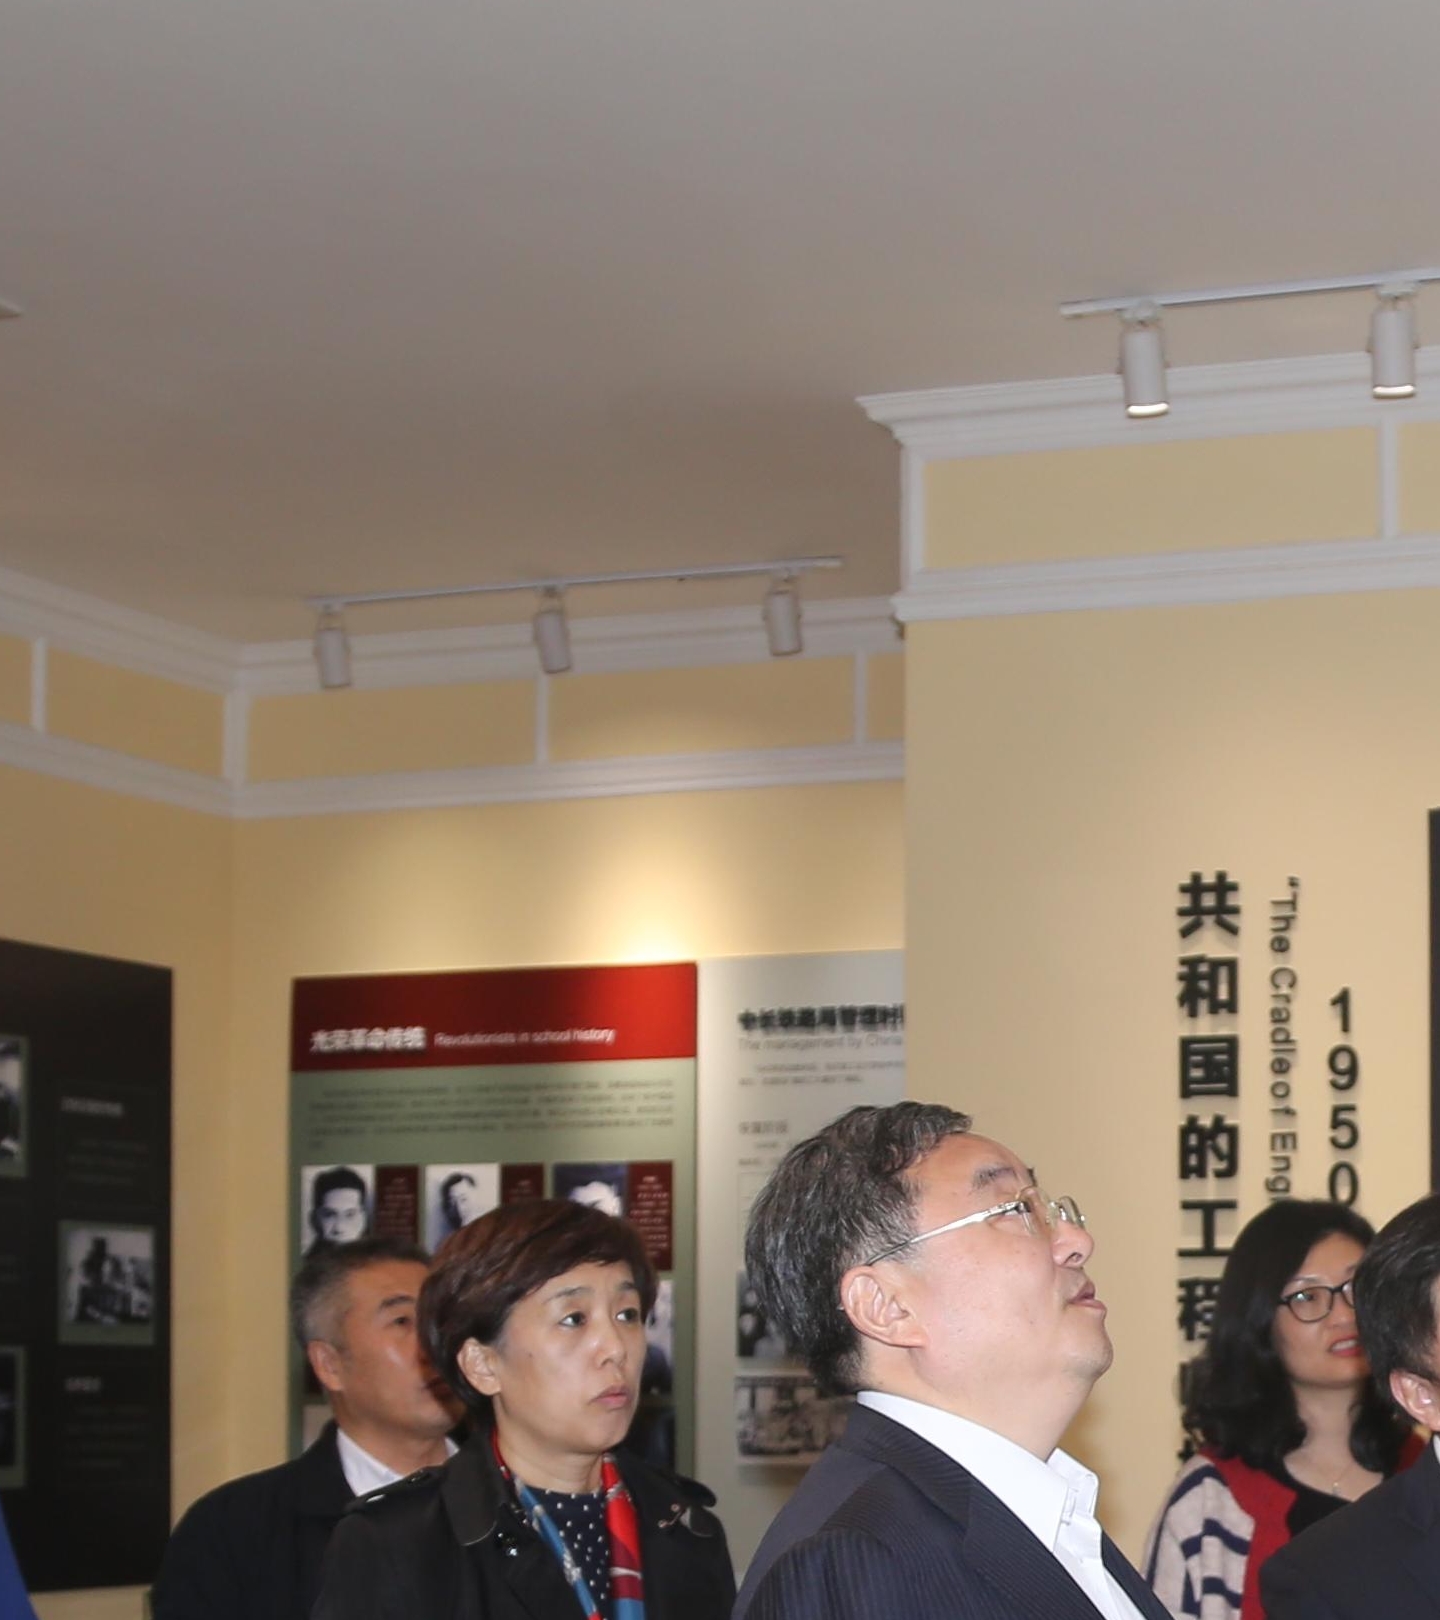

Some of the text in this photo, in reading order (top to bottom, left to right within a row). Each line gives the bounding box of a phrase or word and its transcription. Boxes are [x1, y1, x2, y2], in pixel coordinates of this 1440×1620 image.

[1269, 966, 1298, 1075] Cradle
[1176, 870, 1241, 1410] 共和国的工程
[1270, 1080, 1297, 1117] of
[1327, 986, 1360, 1207] 1950
[1264, 1130, 1298, 1202] Eng
